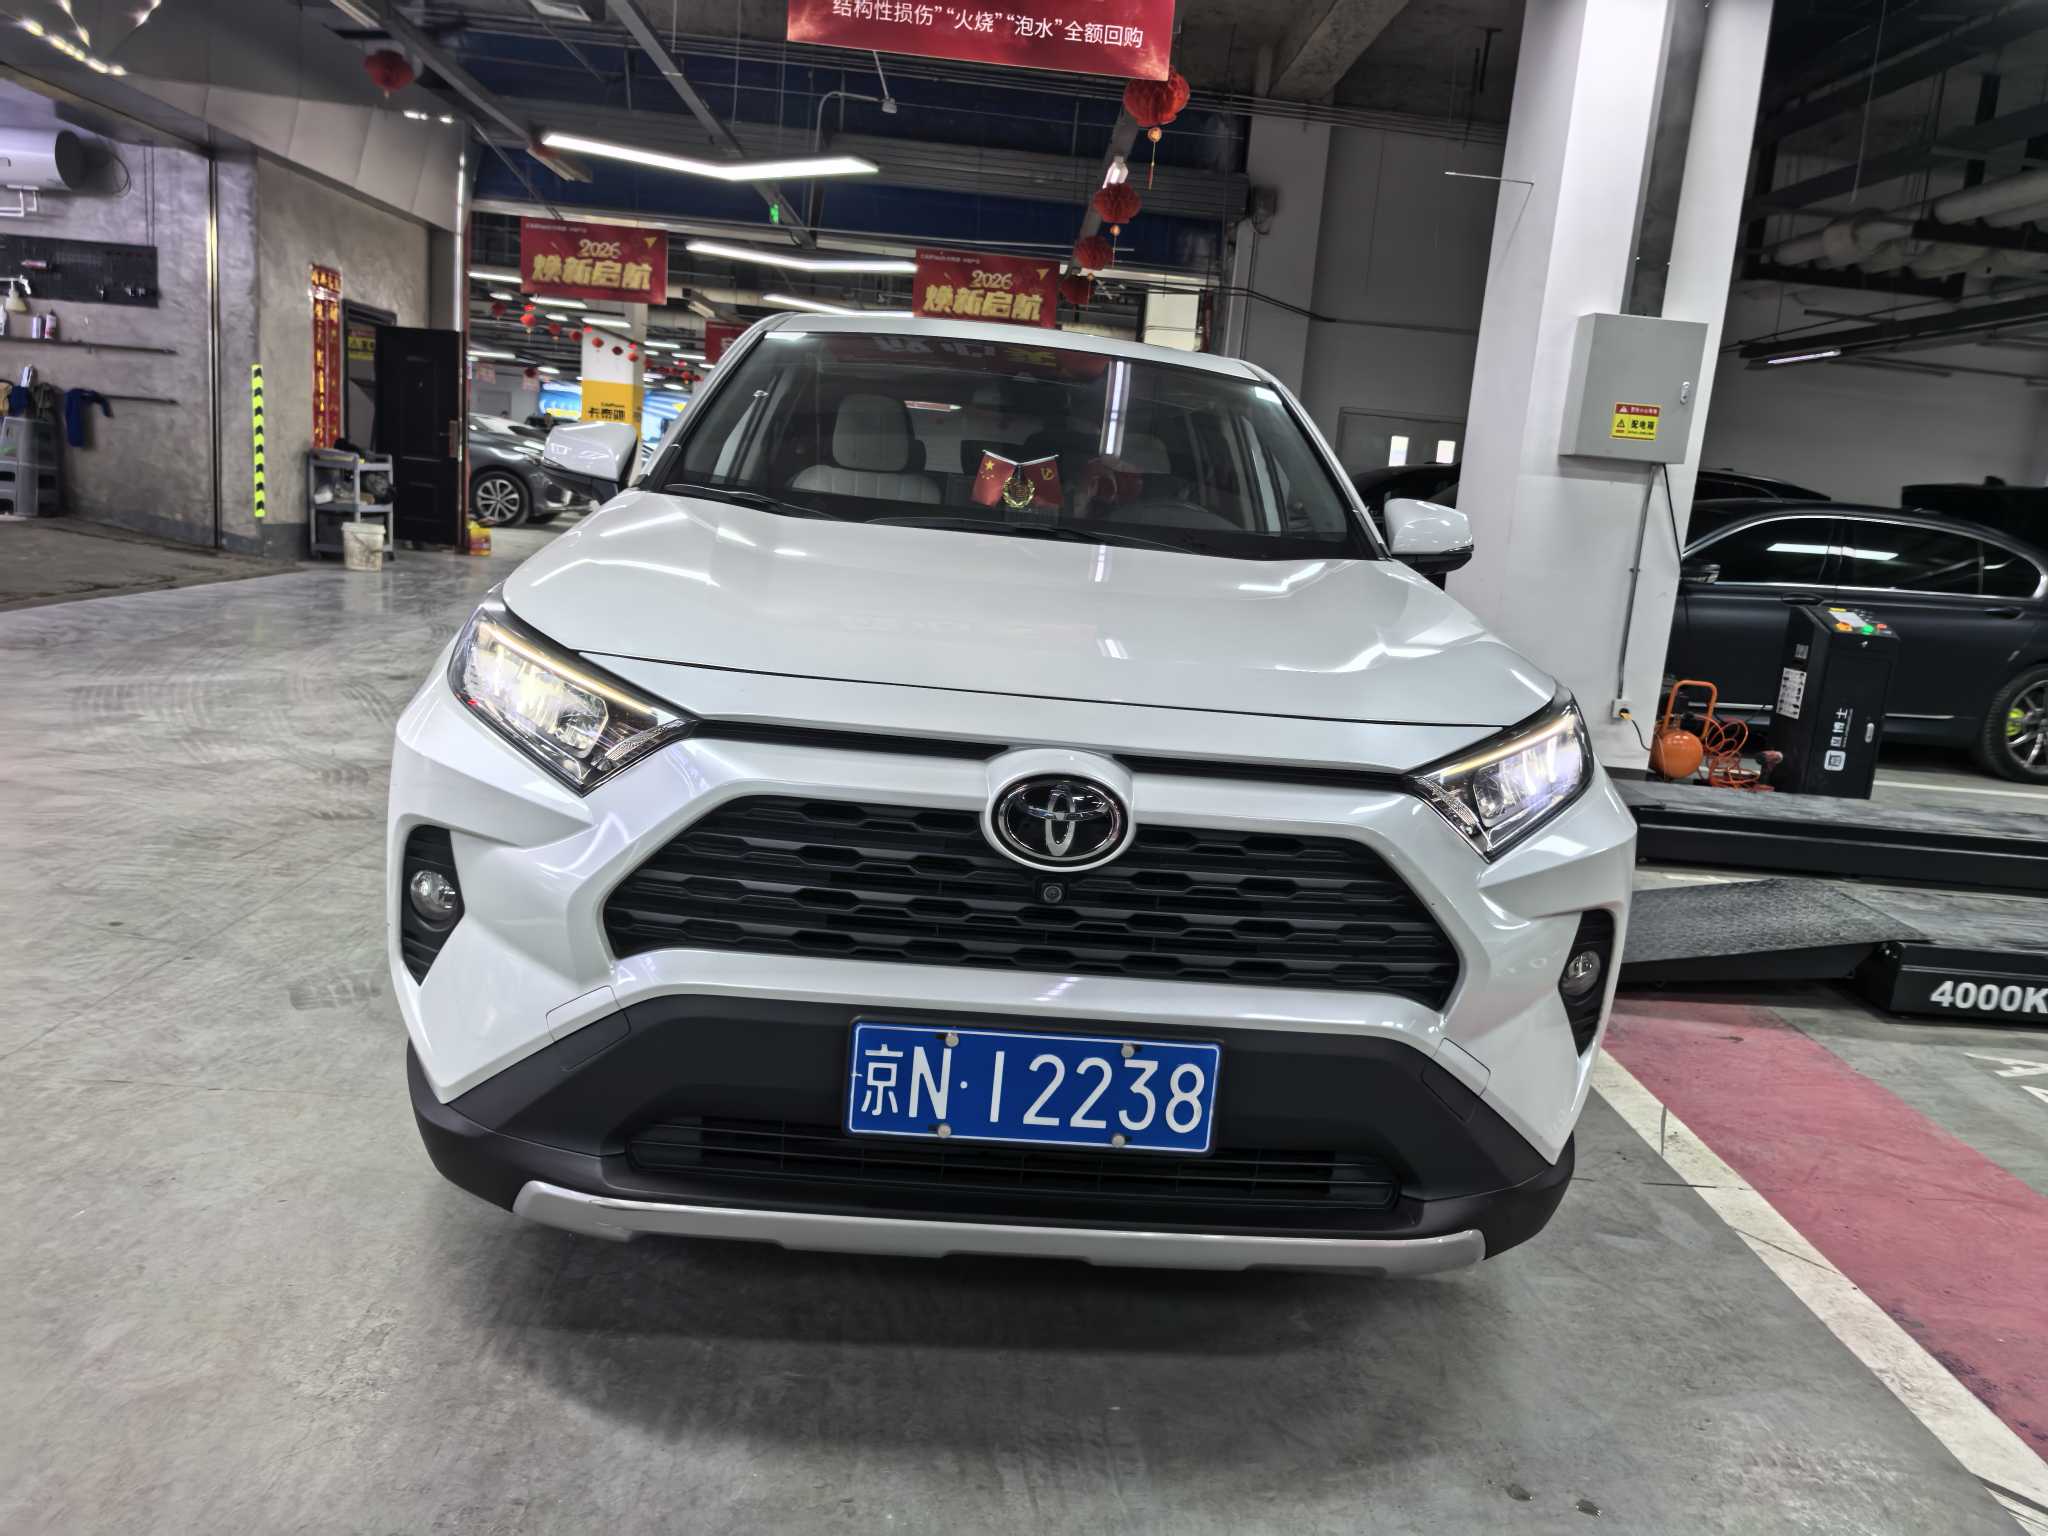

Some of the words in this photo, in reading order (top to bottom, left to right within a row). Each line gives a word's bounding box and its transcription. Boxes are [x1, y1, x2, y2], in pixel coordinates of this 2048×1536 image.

[577, 238, 622, 259] 2026
[532, 254, 652, 291] 焕新启航
[970, 269, 1013, 289] 2026
[922, 284, 1044, 321] 焕新启航
[1930, 980, 2048, 1014] 4000K
[860, 1043, 1205, 1134] 京N·12238
